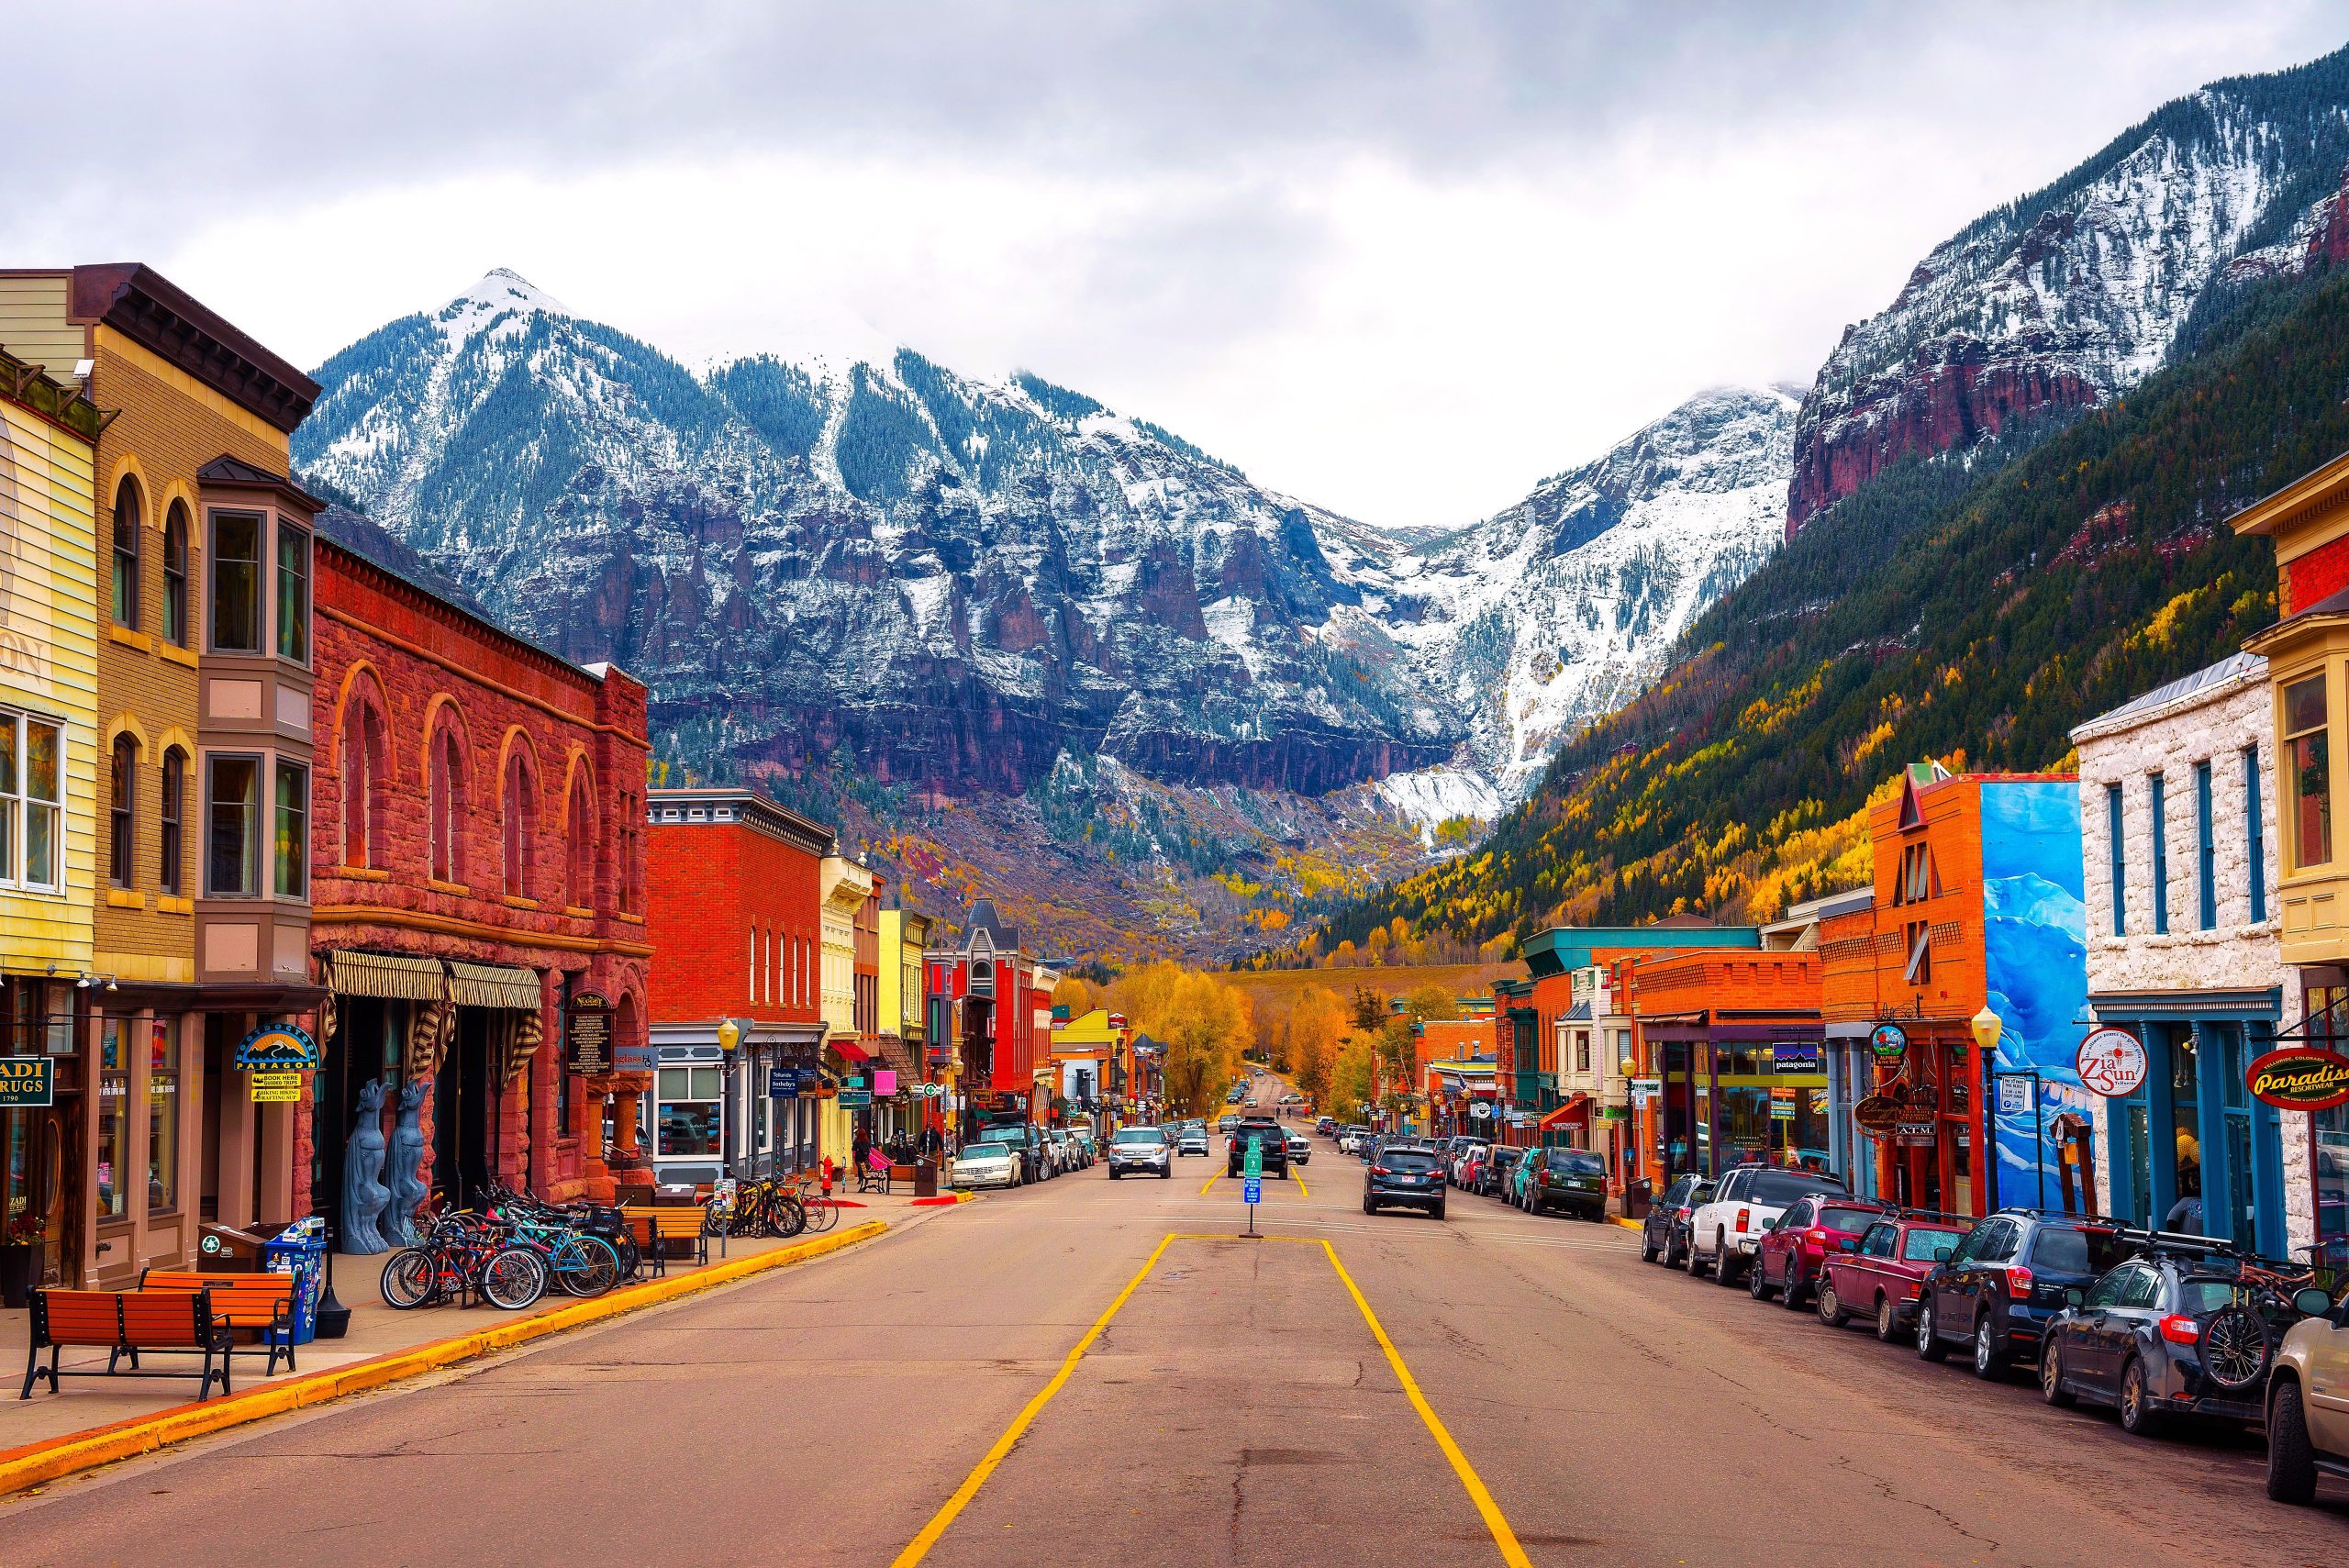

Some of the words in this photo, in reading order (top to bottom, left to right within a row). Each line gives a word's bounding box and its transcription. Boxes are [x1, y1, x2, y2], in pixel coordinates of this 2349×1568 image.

[2080, 1054, 2116, 1080] Zia
[2264, 1057, 2294, 1070] TELLURIDE,
[0, 1081, 43, 1092] RUGS
[2100, 1070, 2136, 1091] Sun
[2290, 1082, 2334, 1093] RESORTWEAR
